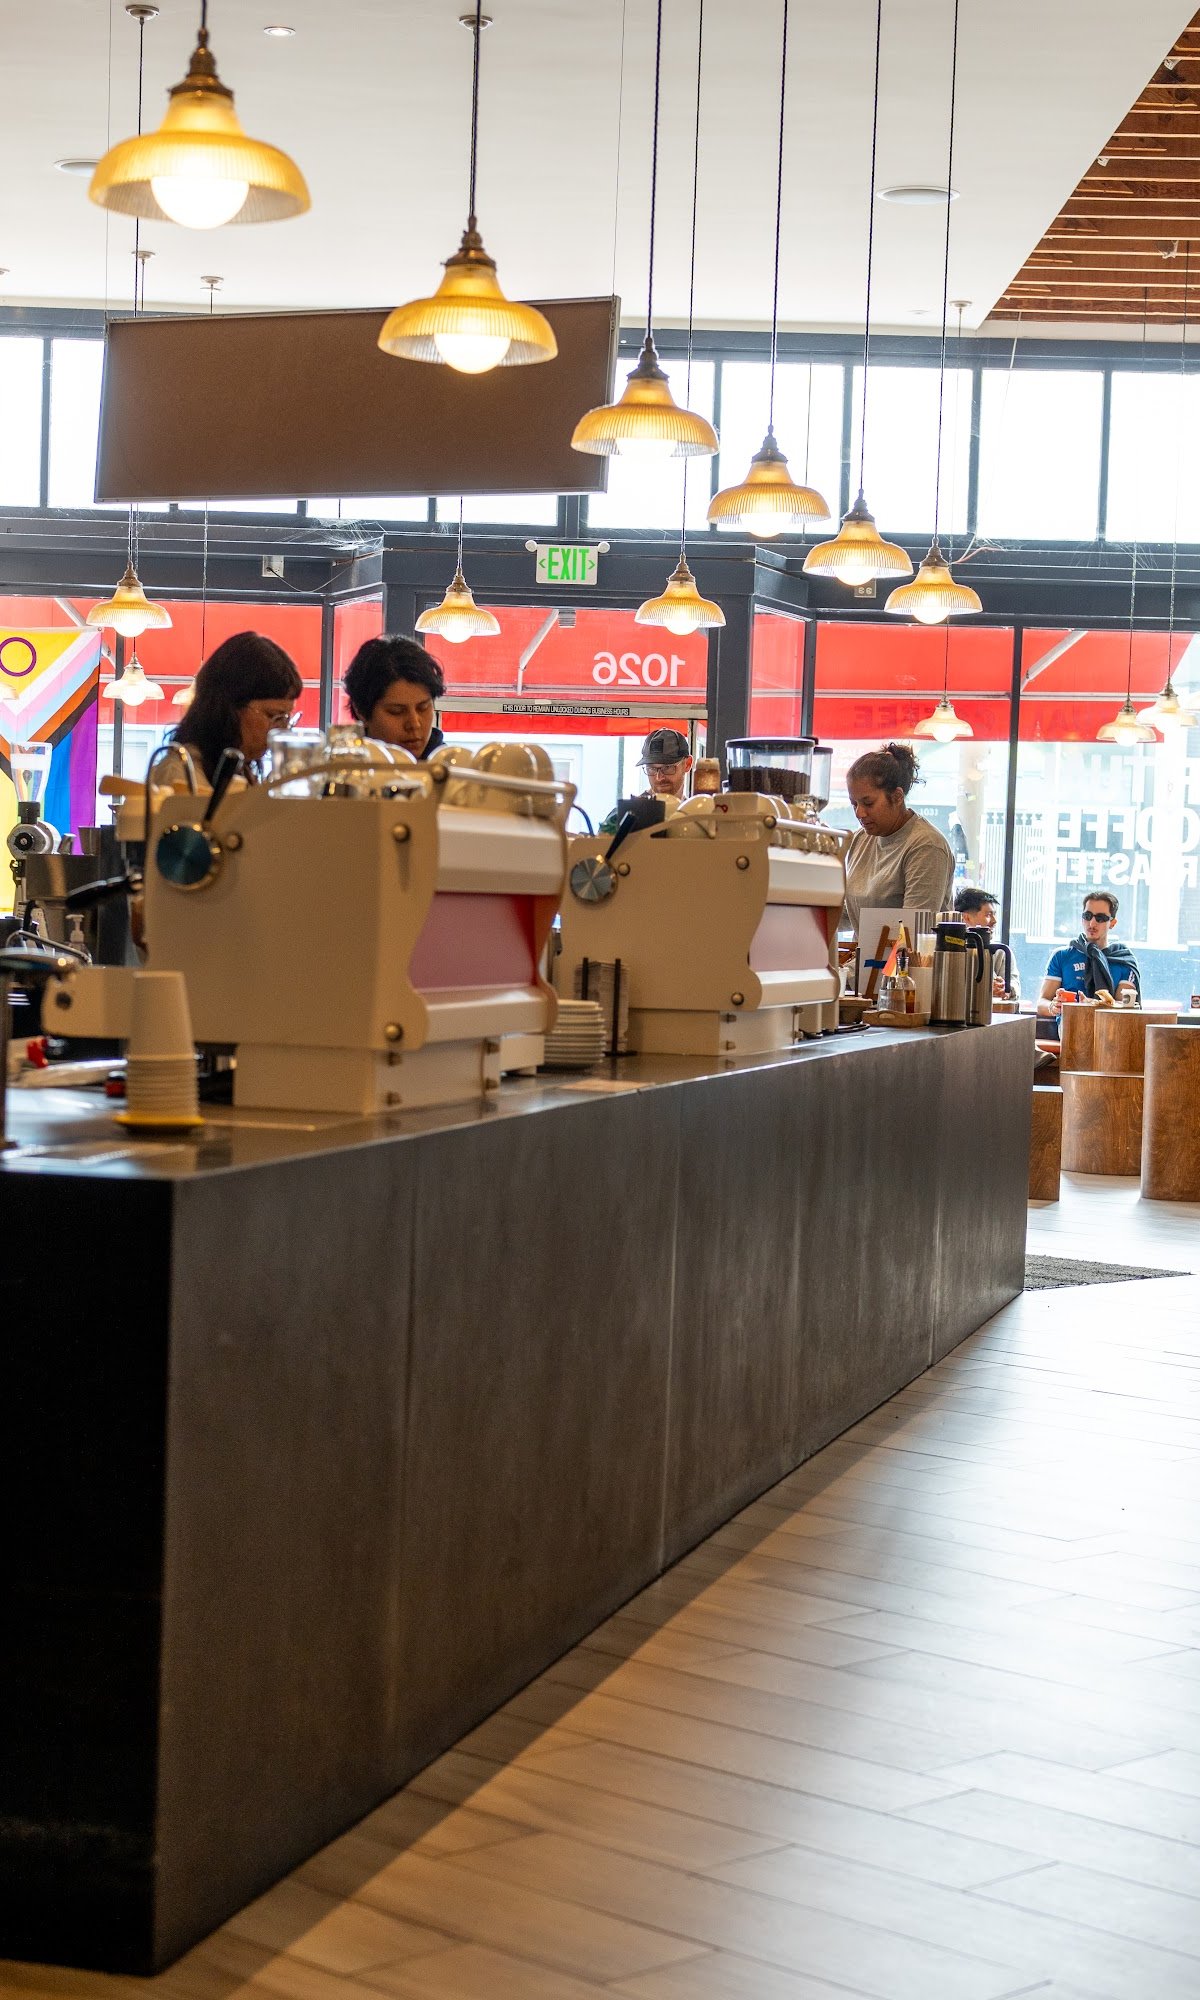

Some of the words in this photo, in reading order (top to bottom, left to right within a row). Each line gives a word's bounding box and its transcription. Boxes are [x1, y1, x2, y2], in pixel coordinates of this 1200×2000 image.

[547, 548, 590, 581] EXIT
[503, 704, 514, 712] THIS
[533, 705, 550, 713] REMAIN
[574, 706, 592, 714] DURING
[592, 707, 613, 715] BUSINESS
[613, 708, 629, 716] HOURS
